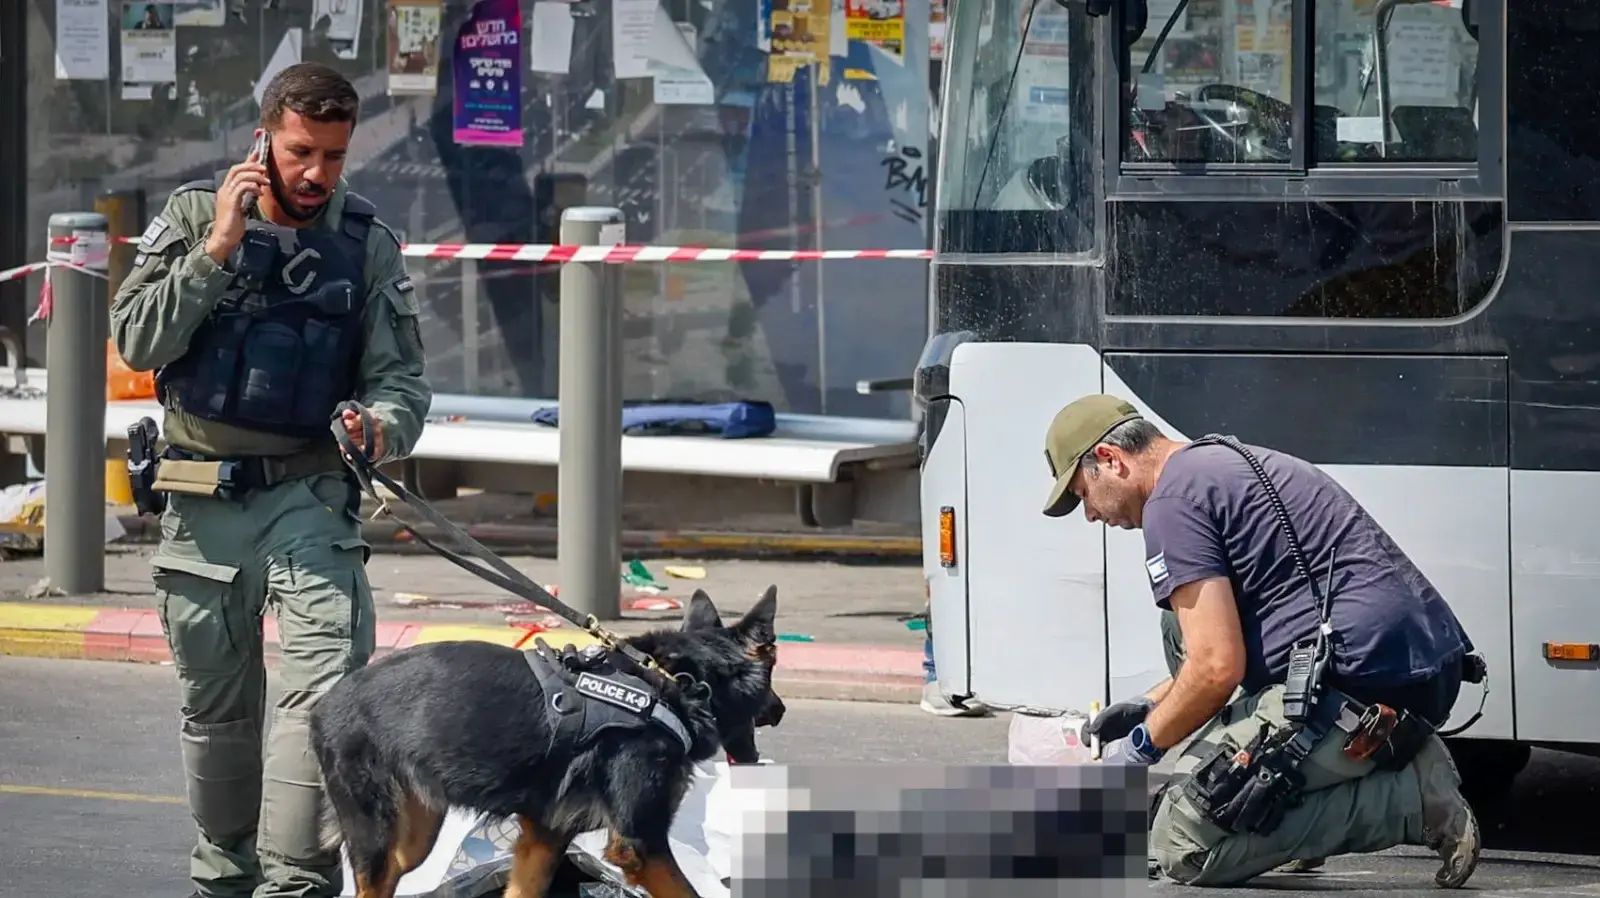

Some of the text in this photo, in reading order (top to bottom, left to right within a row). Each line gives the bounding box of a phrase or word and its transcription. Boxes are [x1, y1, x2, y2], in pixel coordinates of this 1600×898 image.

[477, 20, 506, 34] חדש
[581, 678, 646, 707] POLICE K-9
